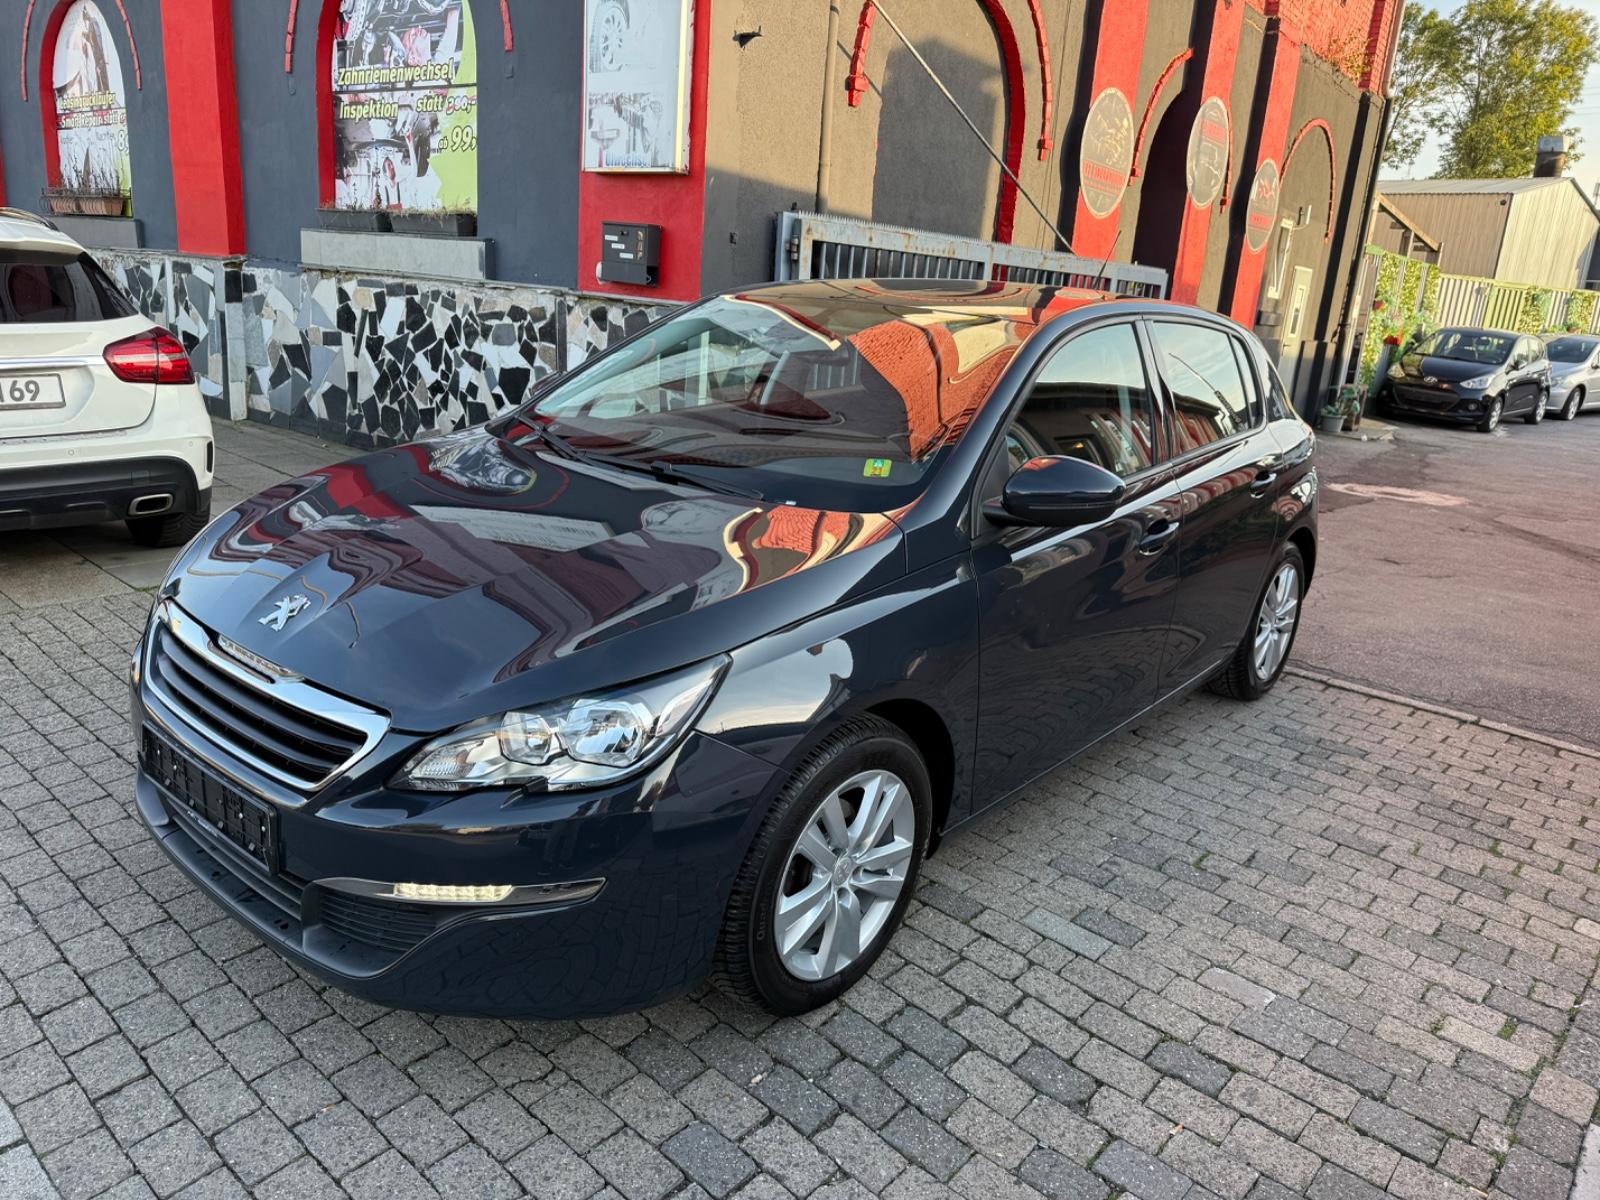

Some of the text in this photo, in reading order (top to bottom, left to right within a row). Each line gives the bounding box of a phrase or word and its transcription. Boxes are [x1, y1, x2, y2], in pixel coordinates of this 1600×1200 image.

[337, 57, 456, 86] Zahnriemenwechsel
[339, 99, 399, 122] Inspektion
[415, 94, 444, 112] statt
[9, 379, 40, 402] 69
